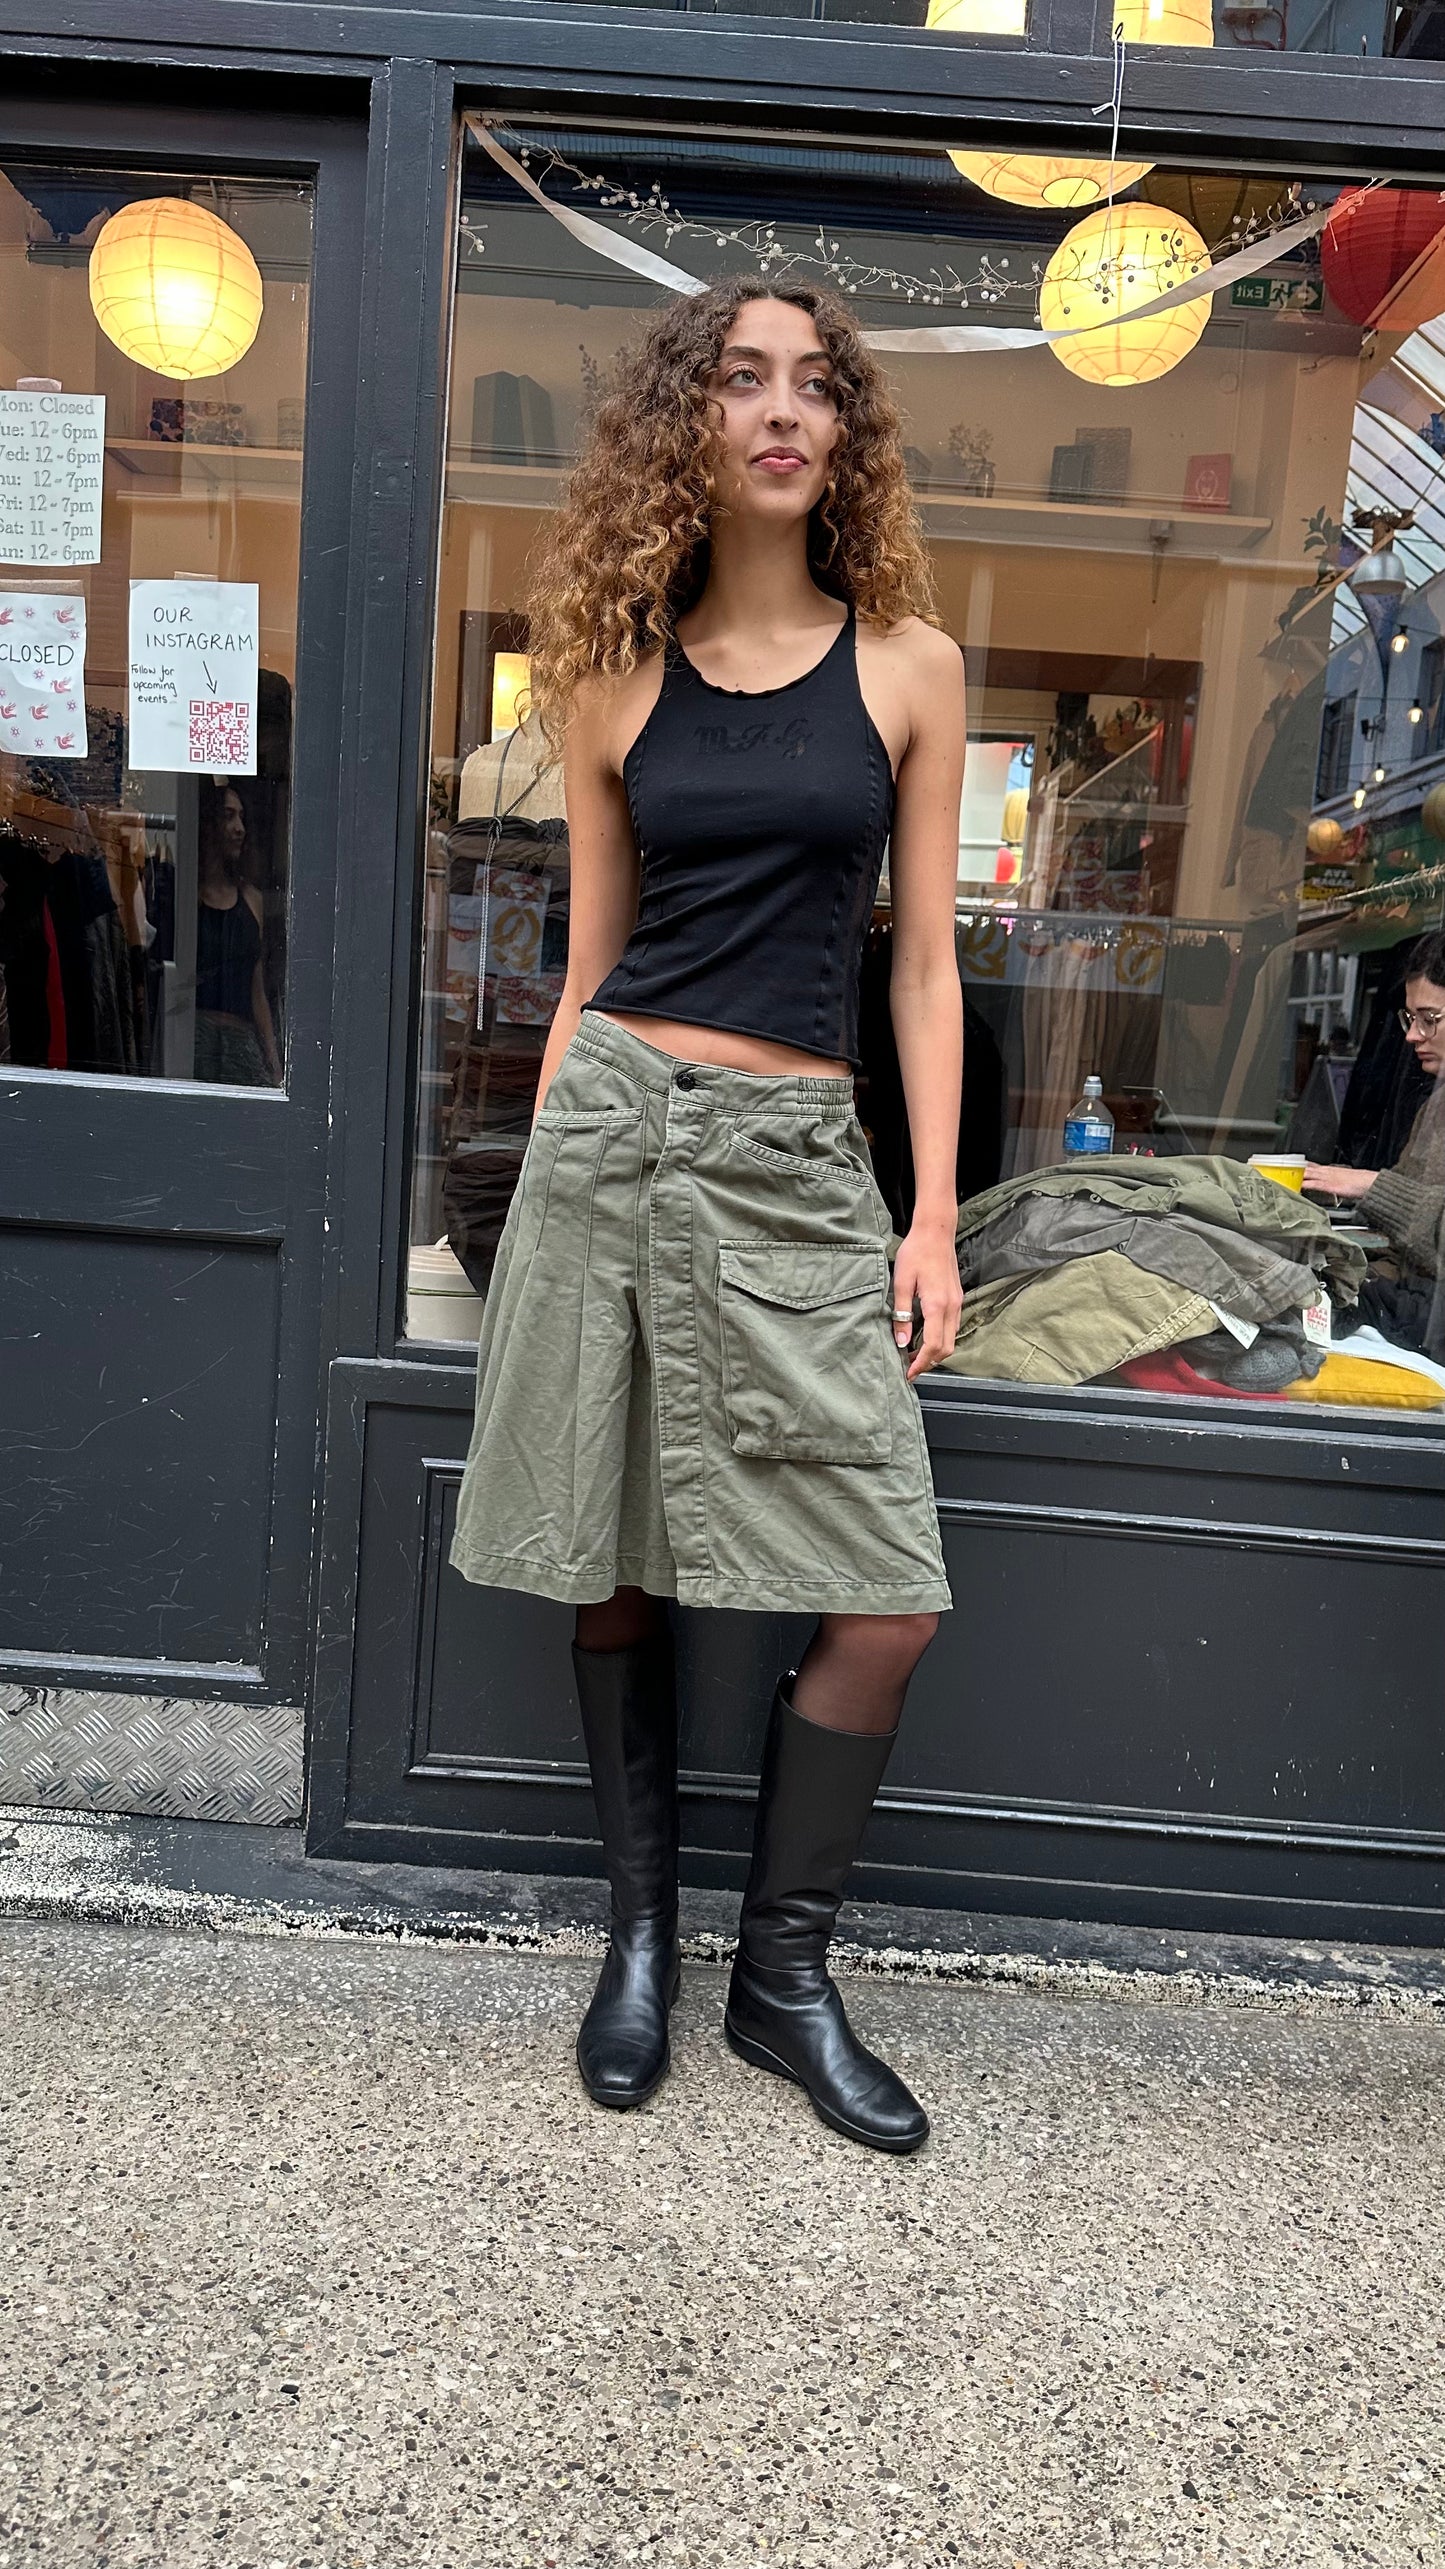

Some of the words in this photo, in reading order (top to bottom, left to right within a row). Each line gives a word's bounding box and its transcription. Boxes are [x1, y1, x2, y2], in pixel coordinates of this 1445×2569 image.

[39, 396, 95, 415] Closed
[0, 424, 24, 437] ue:
[30, 420, 49, 438] 12
[62, 422, 98, 444] 6pm
[35, 446, 53, 463] 12
[66, 447, 102, 469] 6pm
[34, 469, 52, 487] 12
[65, 471, 99, 493] 7pm
[29, 494, 48, 512] 12
[61, 497, 94, 518] 7pm
[31, 520, 45, 536] 11
[62, 521, 94, 542] 7pm
[0, 547, 24, 559] un:
[30, 543, 49, 560] 12
[62, 545, 95, 565] 6pm
[153, 606, 193, 623] OUR
[146, 632, 253, 651] INSTAGRAM
[0, 643, 75, 666] CLOSED
[131, 663, 156, 674] Follow
[159, 664, 175, 683] for
[133, 681, 178, 698] upcoming
